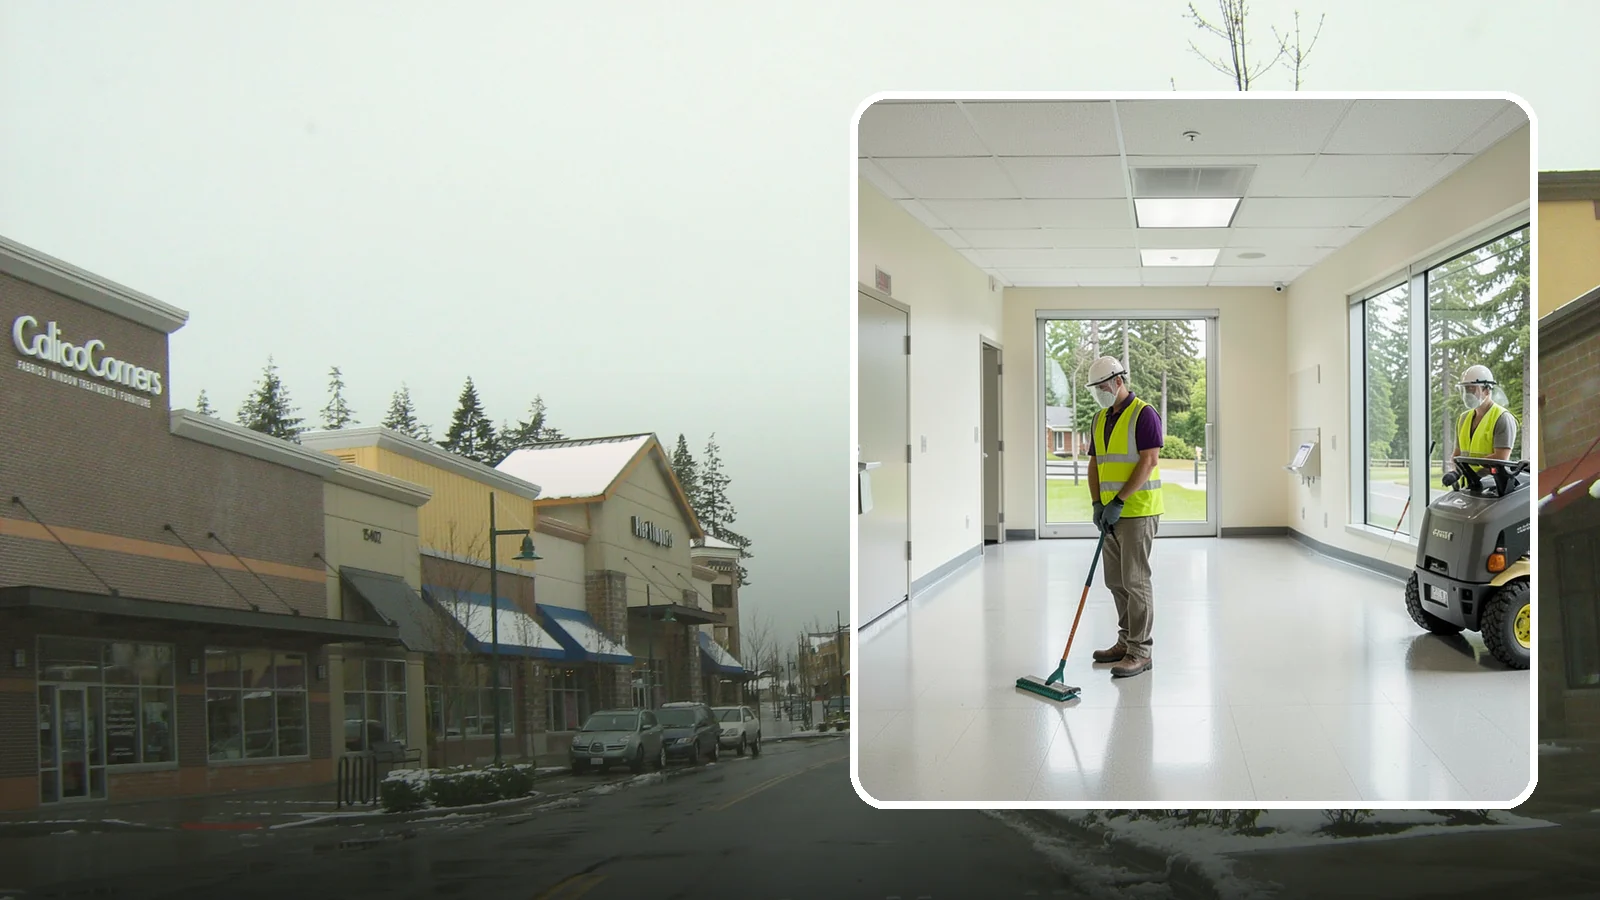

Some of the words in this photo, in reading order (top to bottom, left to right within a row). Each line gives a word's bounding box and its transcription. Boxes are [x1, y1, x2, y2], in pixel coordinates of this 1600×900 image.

[17, 360, 47, 377] FABRICS
[51, 371, 78, 387] WINDOW
[78, 379, 117, 399] TREATMENTS
